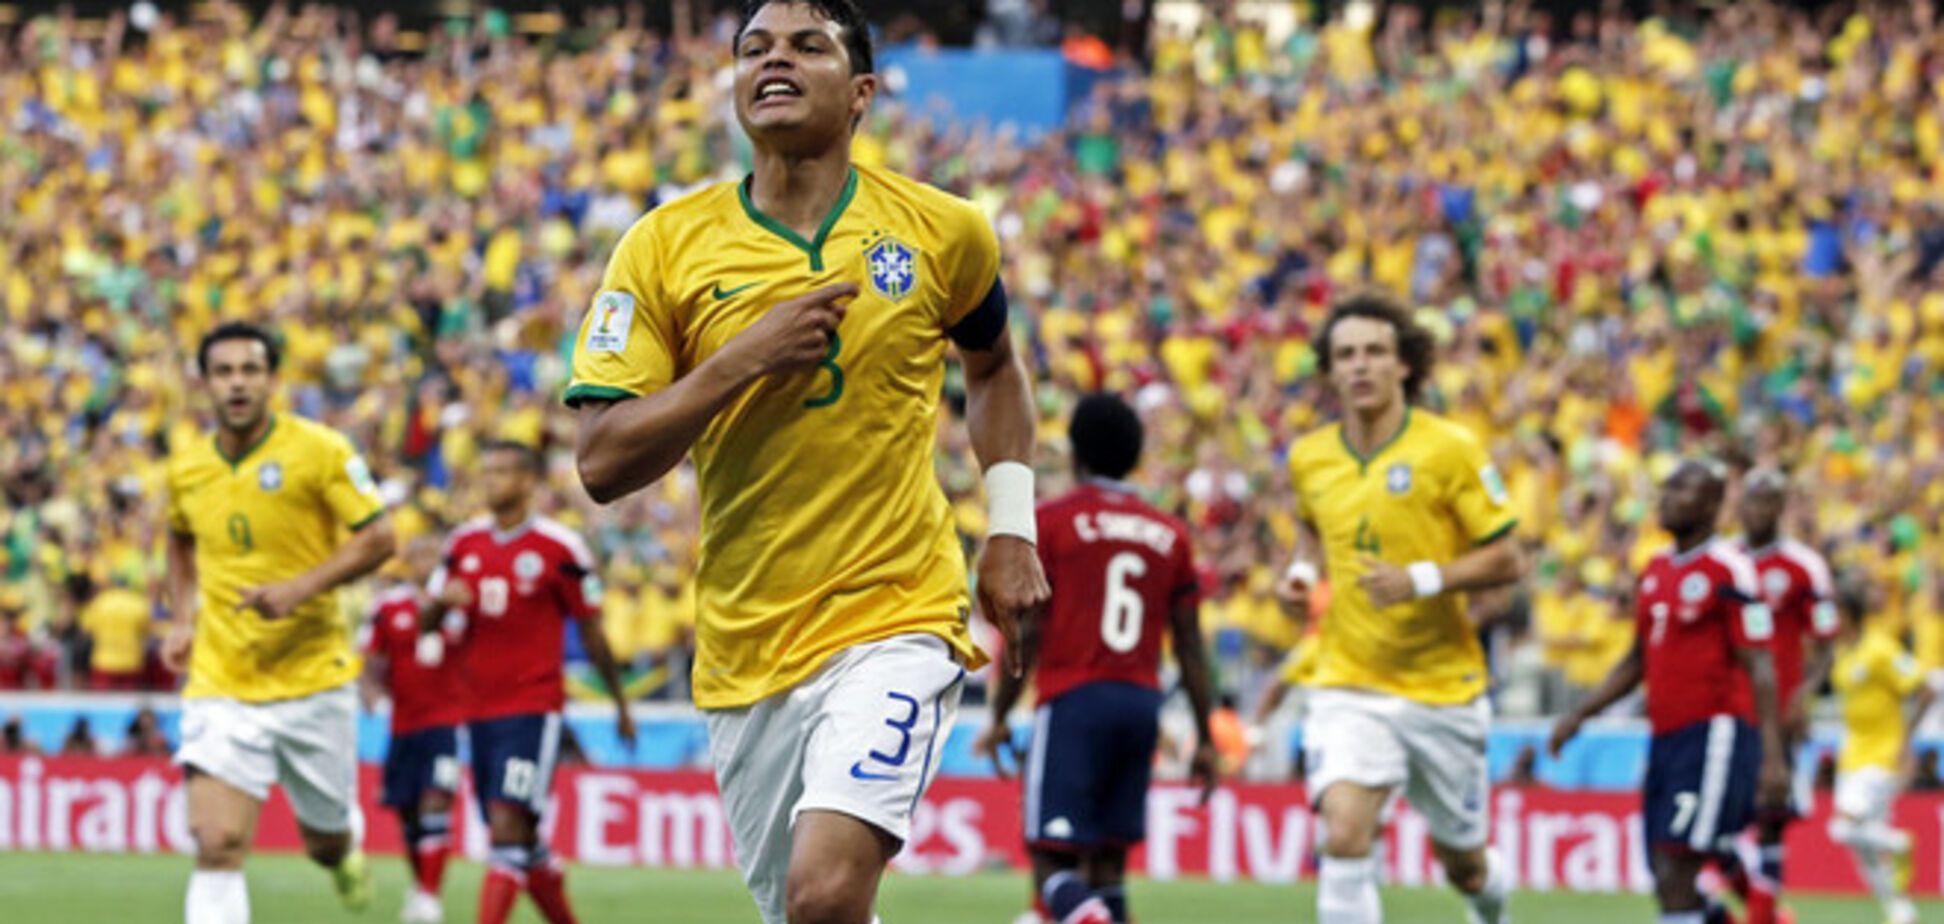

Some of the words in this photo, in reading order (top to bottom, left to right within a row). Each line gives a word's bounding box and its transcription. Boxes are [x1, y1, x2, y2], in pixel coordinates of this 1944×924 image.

[1101, 551, 1147, 653] 6
[869, 691, 920, 767] 3
[1670, 791, 1698, 837] 7
